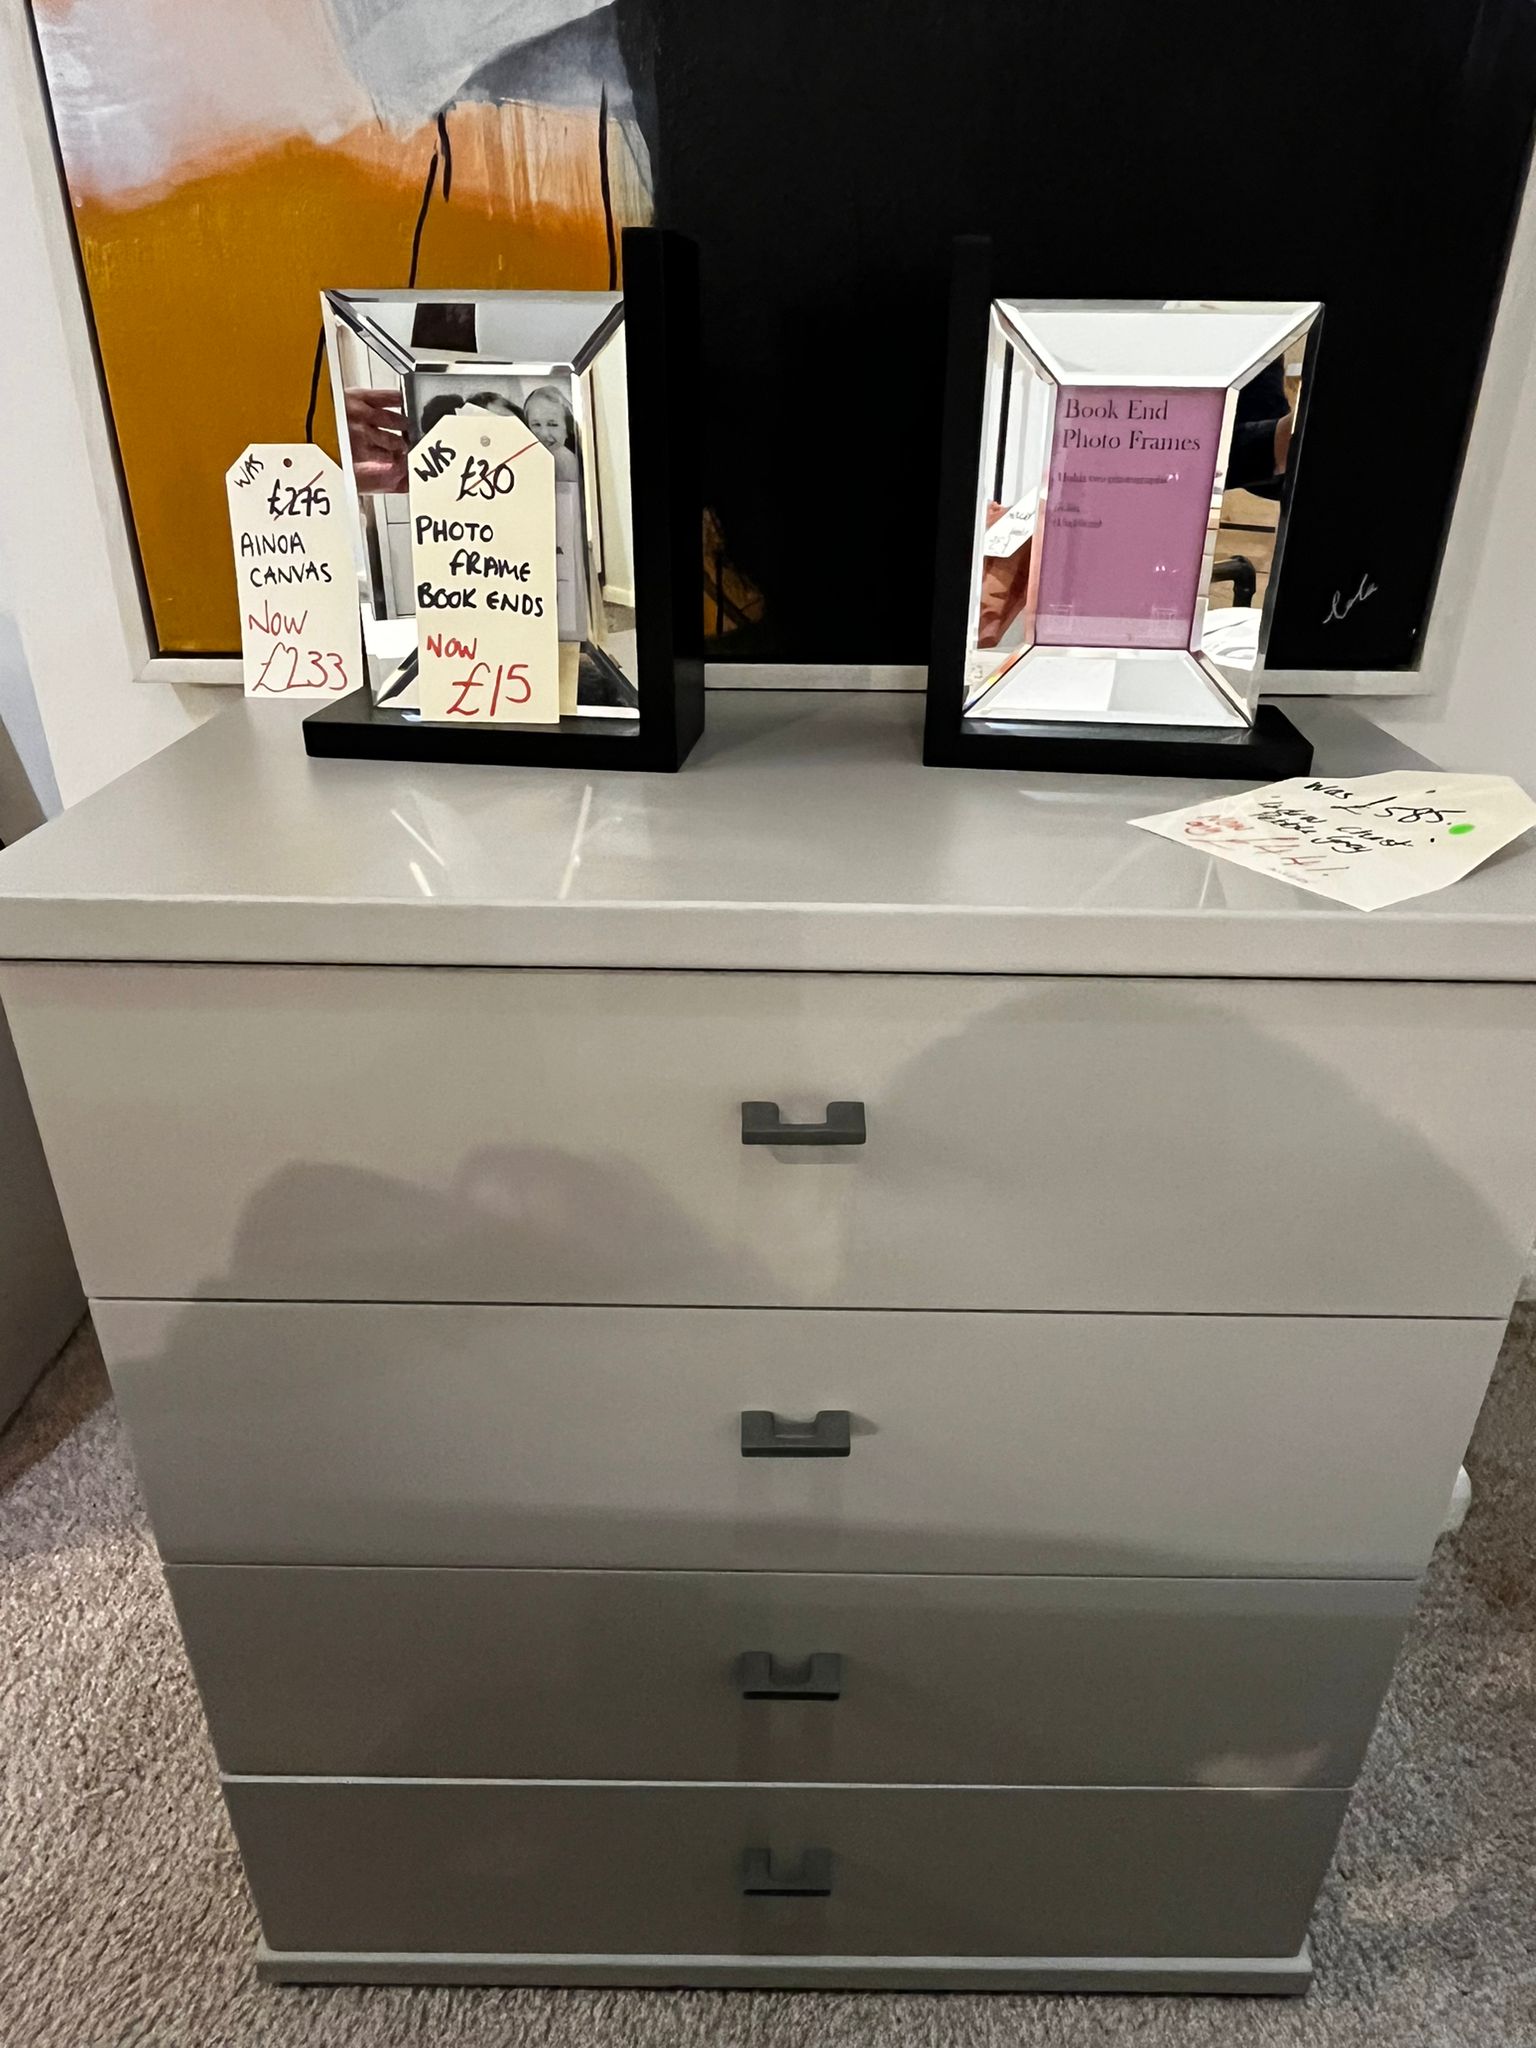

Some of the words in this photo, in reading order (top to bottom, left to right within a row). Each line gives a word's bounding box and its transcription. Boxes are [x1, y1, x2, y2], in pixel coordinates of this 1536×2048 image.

[1065, 399, 1119, 420] Book
[1127, 399, 1169, 421] End
[1062, 428, 1121, 450] Photo
[1129, 430, 1202, 451] Frames
[234, 453, 264, 488] WAS
[414, 440, 457, 482] WAS
[456, 455, 515, 501] £30
[267, 478, 331, 518] £275
[241, 531, 306, 557] AINOA
[416, 515, 494, 545] PHOTO
[250, 561, 333, 588] CANVAS
[449, 549, 532, 583] FRAME
[417, 582, 478, 609] BOOK
[486, 590, 544, 618] ENDS
[426, 633, 478, 660] NOW
[252, 642, 348, 693] £233
[446, 662, 532, 717] £15
